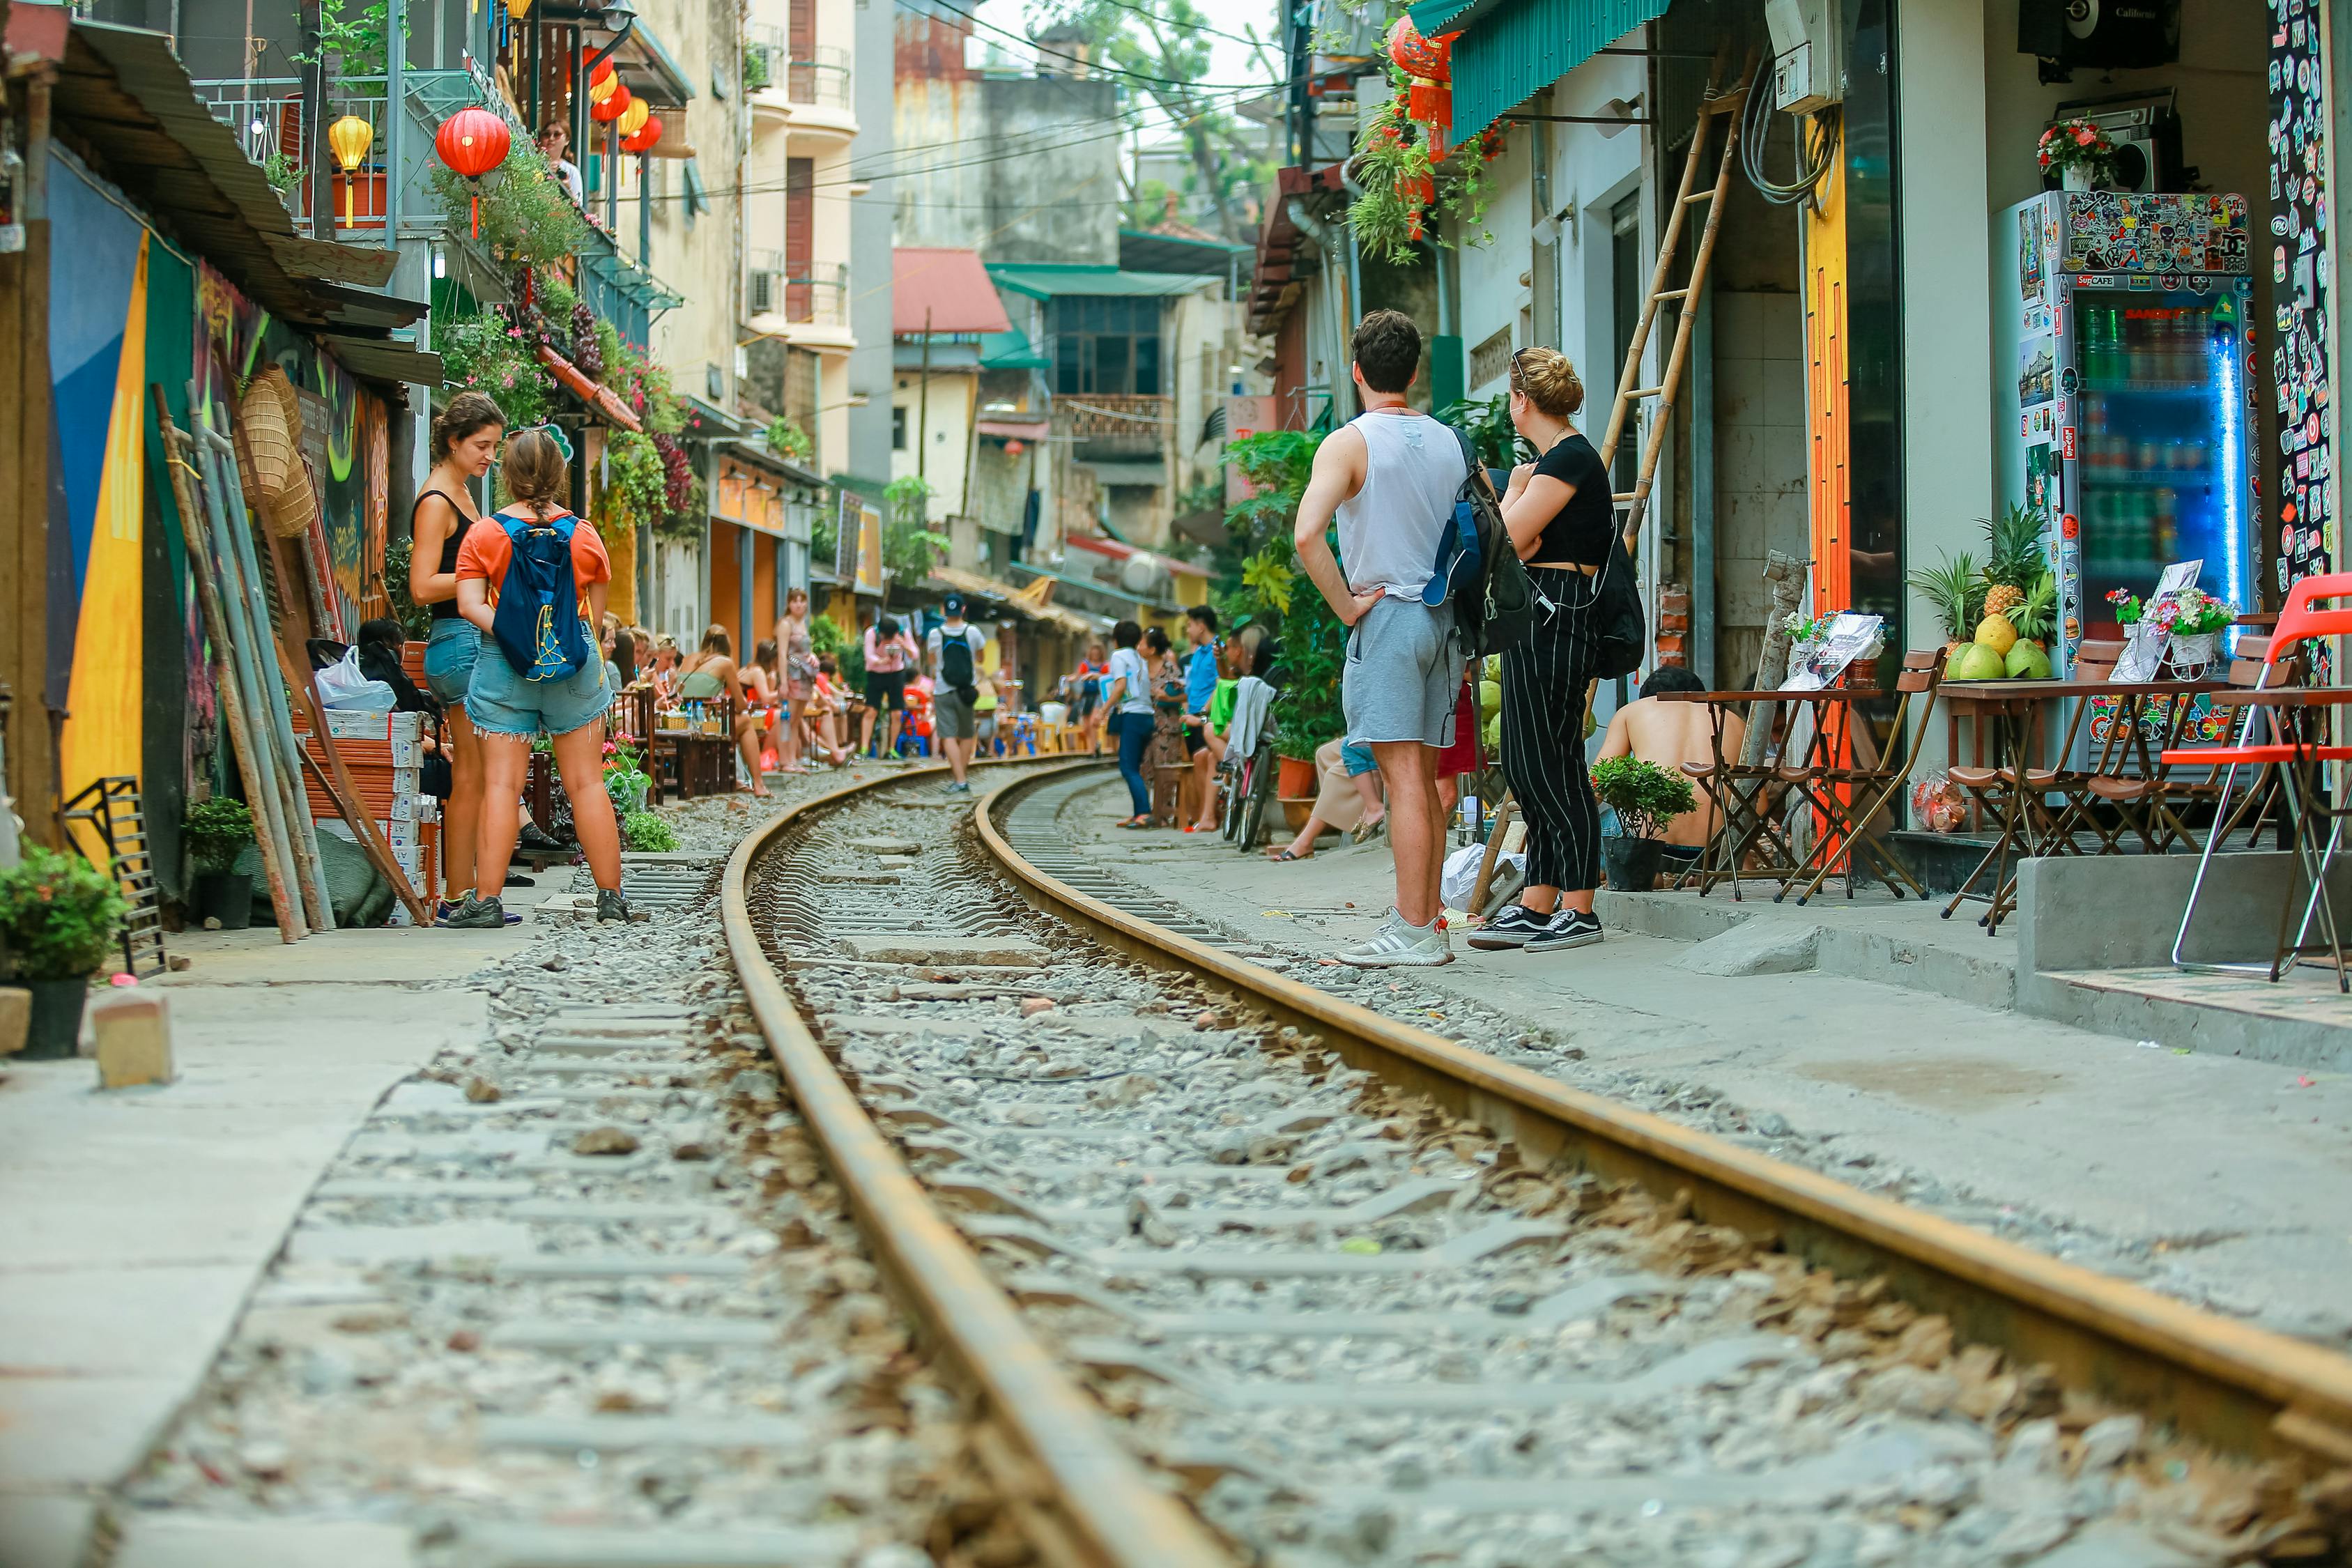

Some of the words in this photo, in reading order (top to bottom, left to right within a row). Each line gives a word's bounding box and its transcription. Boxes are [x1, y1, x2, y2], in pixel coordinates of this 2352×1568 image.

[403, 756, 410, 765] A1
[404, 783, 410, 792] A1
[400, 810, 408, 819] A1
